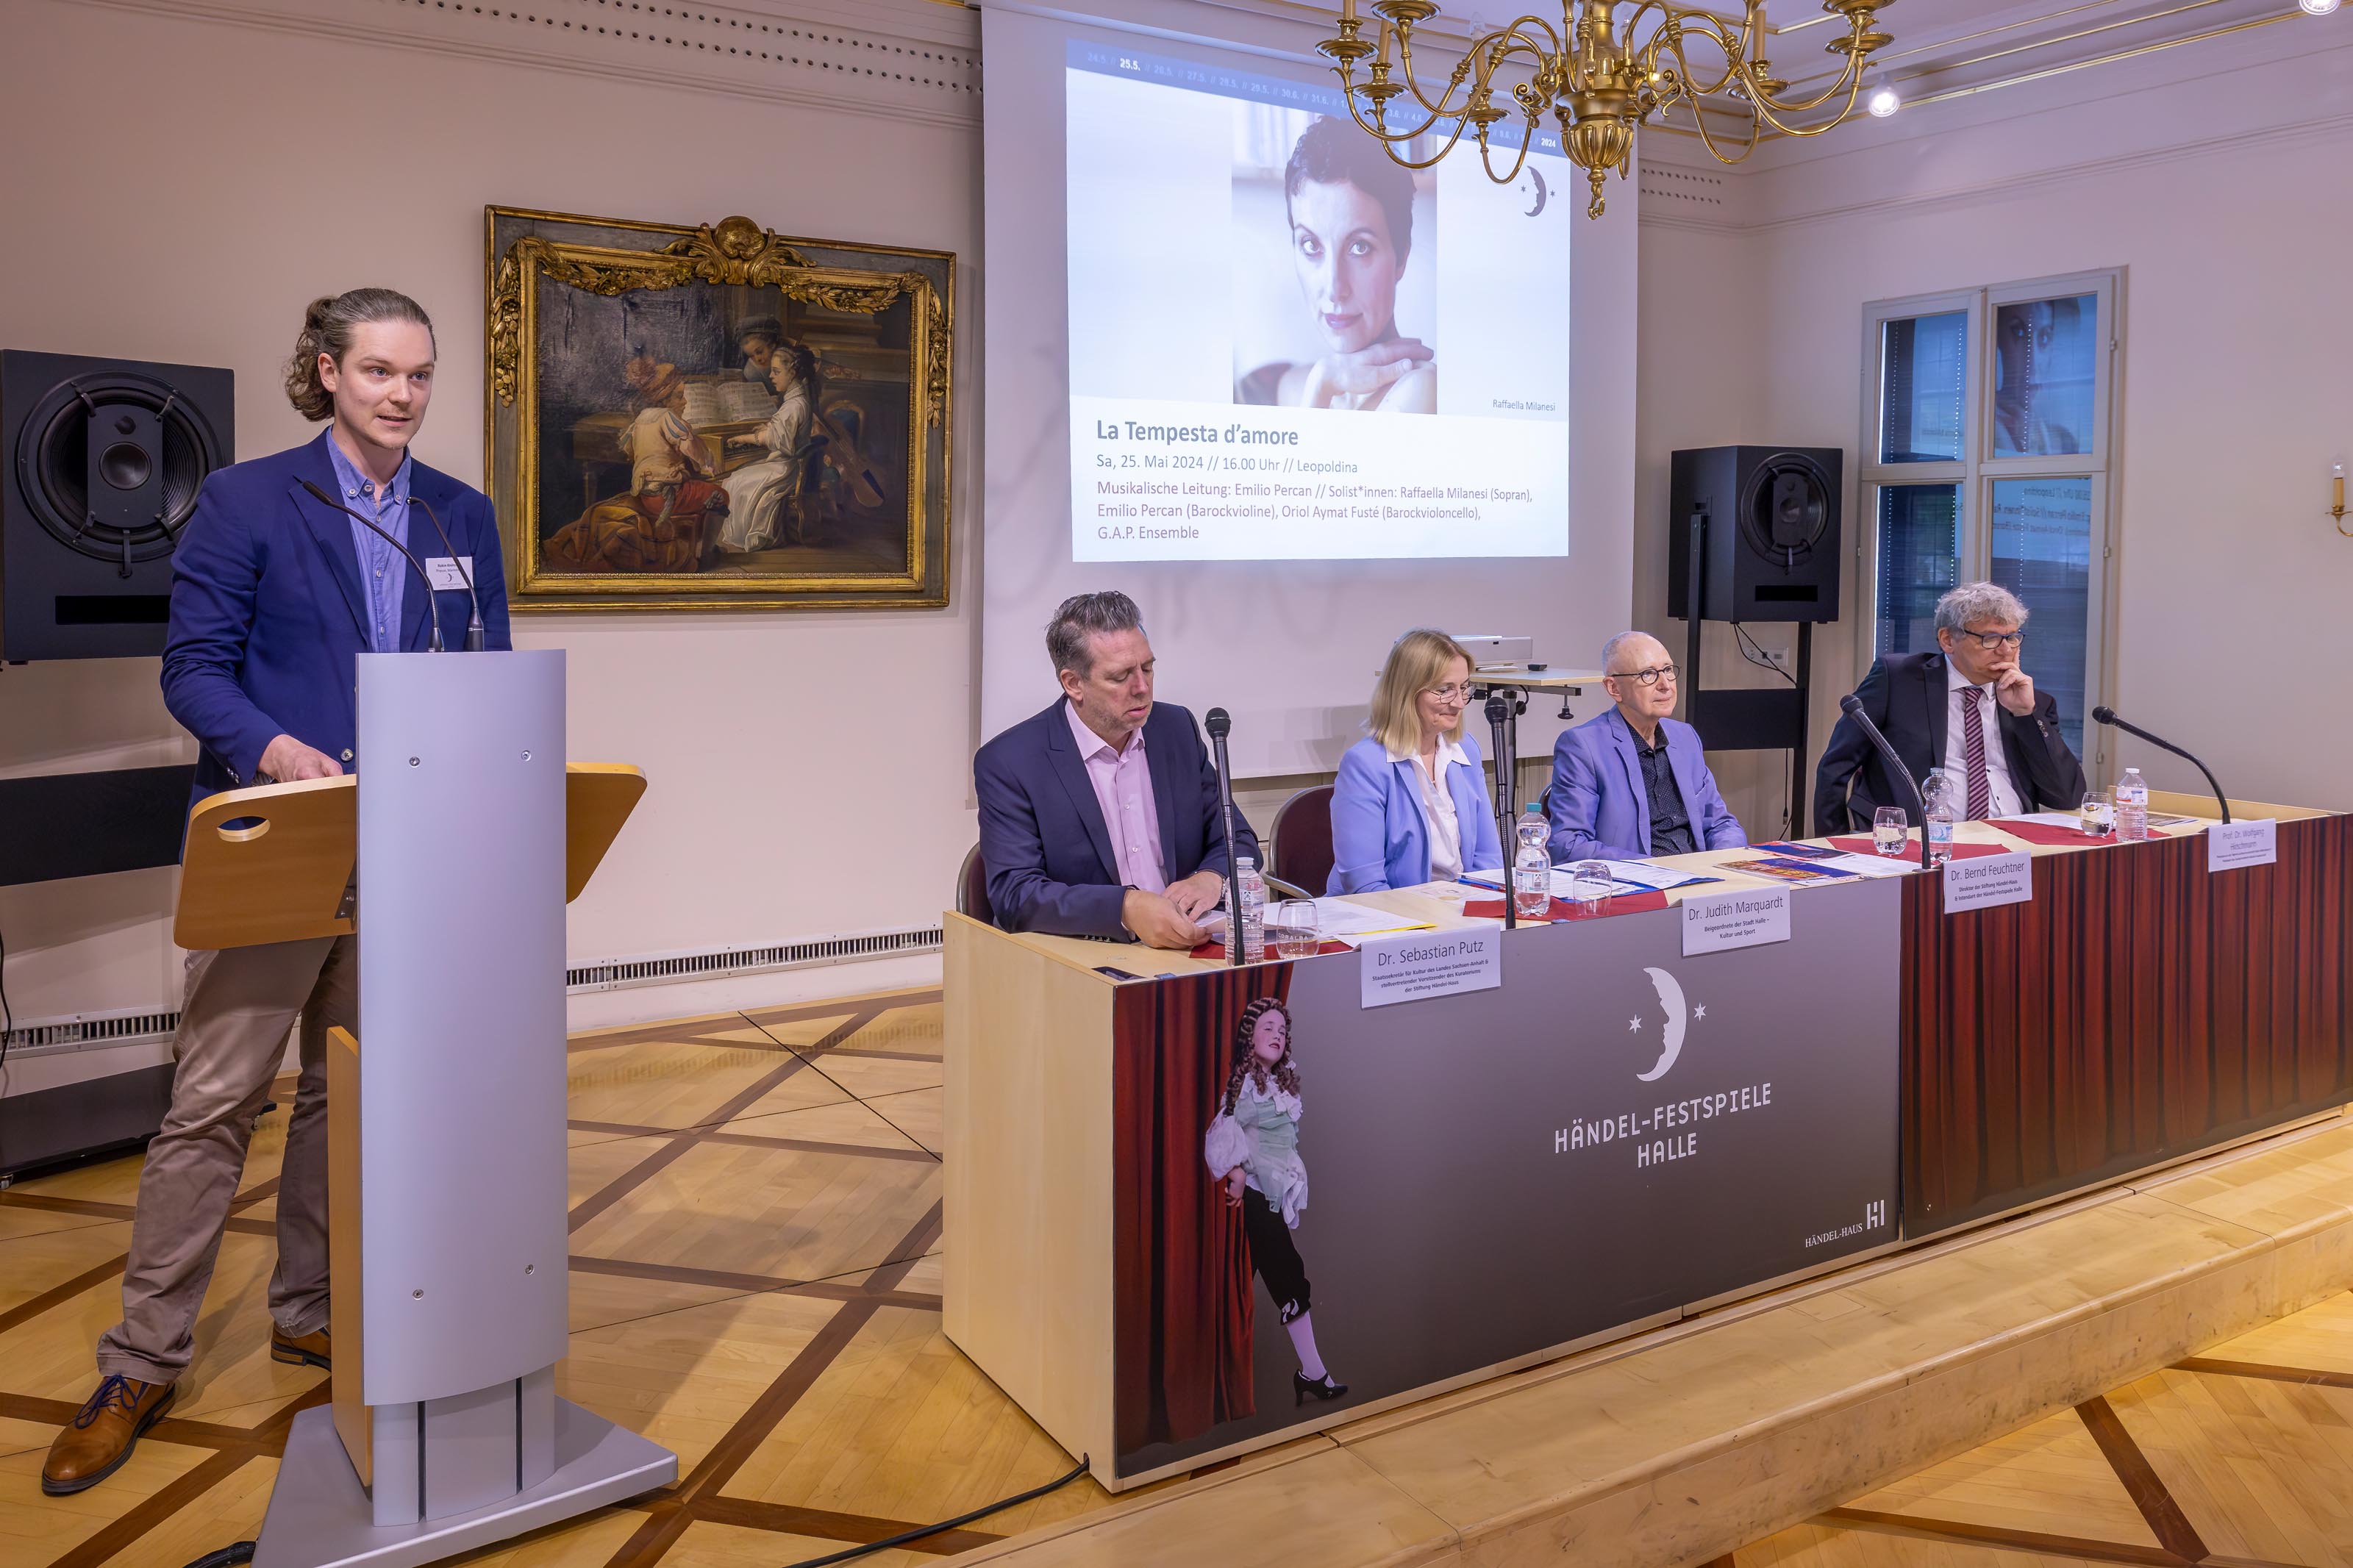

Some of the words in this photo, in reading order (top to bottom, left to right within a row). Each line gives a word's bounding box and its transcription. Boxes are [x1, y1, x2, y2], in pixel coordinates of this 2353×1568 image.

[1119, 57, 1141, 71] 25.5.
[1540, 137, 1557, 148] 2024
[1493, 399, 1524, 410] Raffaella
[1525, 401, 1556, 412] Milanesi
[1096, 419, 1118, 440] La
[1124, 420, 1218, 445] Tempesta
[1096, 454, 1116, 470] Sa,
[1121, 454, 1140, 468] 25.
[1144, 454, 1168, 468] Mai
[1172, 455, 1204, 469] 2024
[1207, 456, 1219, 471] //
[1223, 457, 1255, 470] 16.00
[1259, 457, 1280, 471] Uhr
[1282, 457, 1294, 473] //
[1297, 459, 1357, 475] Leopoldina
[1097, 481, 1178, 495] Musikalische
[1182, 482, 1231, 498] Leitung:
[1235, 483, 1271, 496] Emilio
[1274, 483, 1312, 497] Percan
[1315, 483, 1326, 499] //
[1400, 486, 1444, 500] Raffaella
[1447, 487, 1488, 501] Milanesi
[1490, 487, 1533, 504] (Sopran),
[1097, 503, 1138, 517] Emilio
[1141, 504, 1182, 518] Percan
[1187, 503, 1278, 520] (Barockvioline),
[1282, 505, 1309, 518] Oriol
[1313, 505, 1348, 520] Aymat
[1352, 505, 1379, 519] Fusté
[1382, 506, 1481, 521] (Barockvioloncello),
[1098, 526, 1135, 540] G.A.P.
[1139, 526, 1199, 540] Ensemble
[1951, 870, 1963, 881] Dr.
[1965, 865, 1987, 879] Bernd
[1988, 862, 2025, 876] Feuchtner
[1688, 909, 1702, 920] Dr.
[1705, 904, 1732, 919] Judith
[1735, 895, 1783, 914] Marquardt
[1704, 922, 1734, 932] Beigeordnete
[1743, 919, 1754, 927] Stadt
[1743, 928, 1755, 937] Sport
[1378, 953, 1396, 966] Dr.
[1399, 944, 1455, 964] Sebastian
[1460, 940, 1484, 955] Putz
[1372, 970, 1404, 981] Staatssekretär
[1452, 959, 1485, 970] Sachsen-Anhalt
[1381, 978, 1418, 989] stellvertretender
[1418, 973, 1446, 983] Vorsitzender
[1454, 968, 1481, 977] Kuratoriums
[1413, 984, 1431, 992] Stiftung
[1432, 980, 1459, 989] Händel-Haus
[1554, 1082, 1771, 1154] HÄNDEL-FESTSPIELE
[1638, 1132, 1697, 1168] HALLE
[1804, 1222, 1863, 1248] HÄNDEL-HAUS
